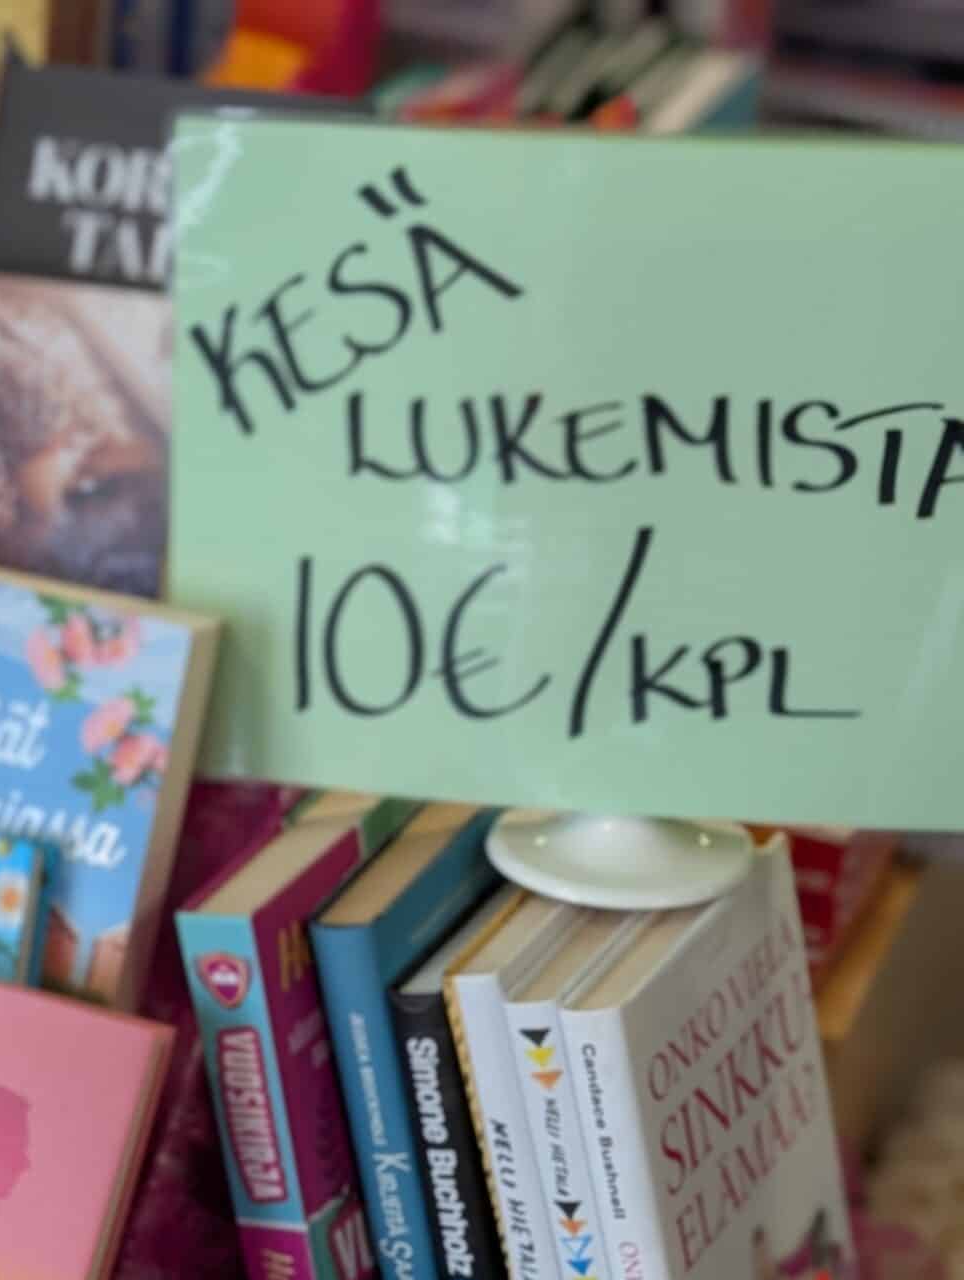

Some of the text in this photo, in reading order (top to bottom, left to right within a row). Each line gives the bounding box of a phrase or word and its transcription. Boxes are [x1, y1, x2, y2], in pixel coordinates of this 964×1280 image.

[188, 166, 526, 434] KESÄ
[405, 1036, 452, 1150] Simone
[580, 1042, 626, 1222] Candace Bushnell
[426, 1148, 474, 1280] Buchholz
